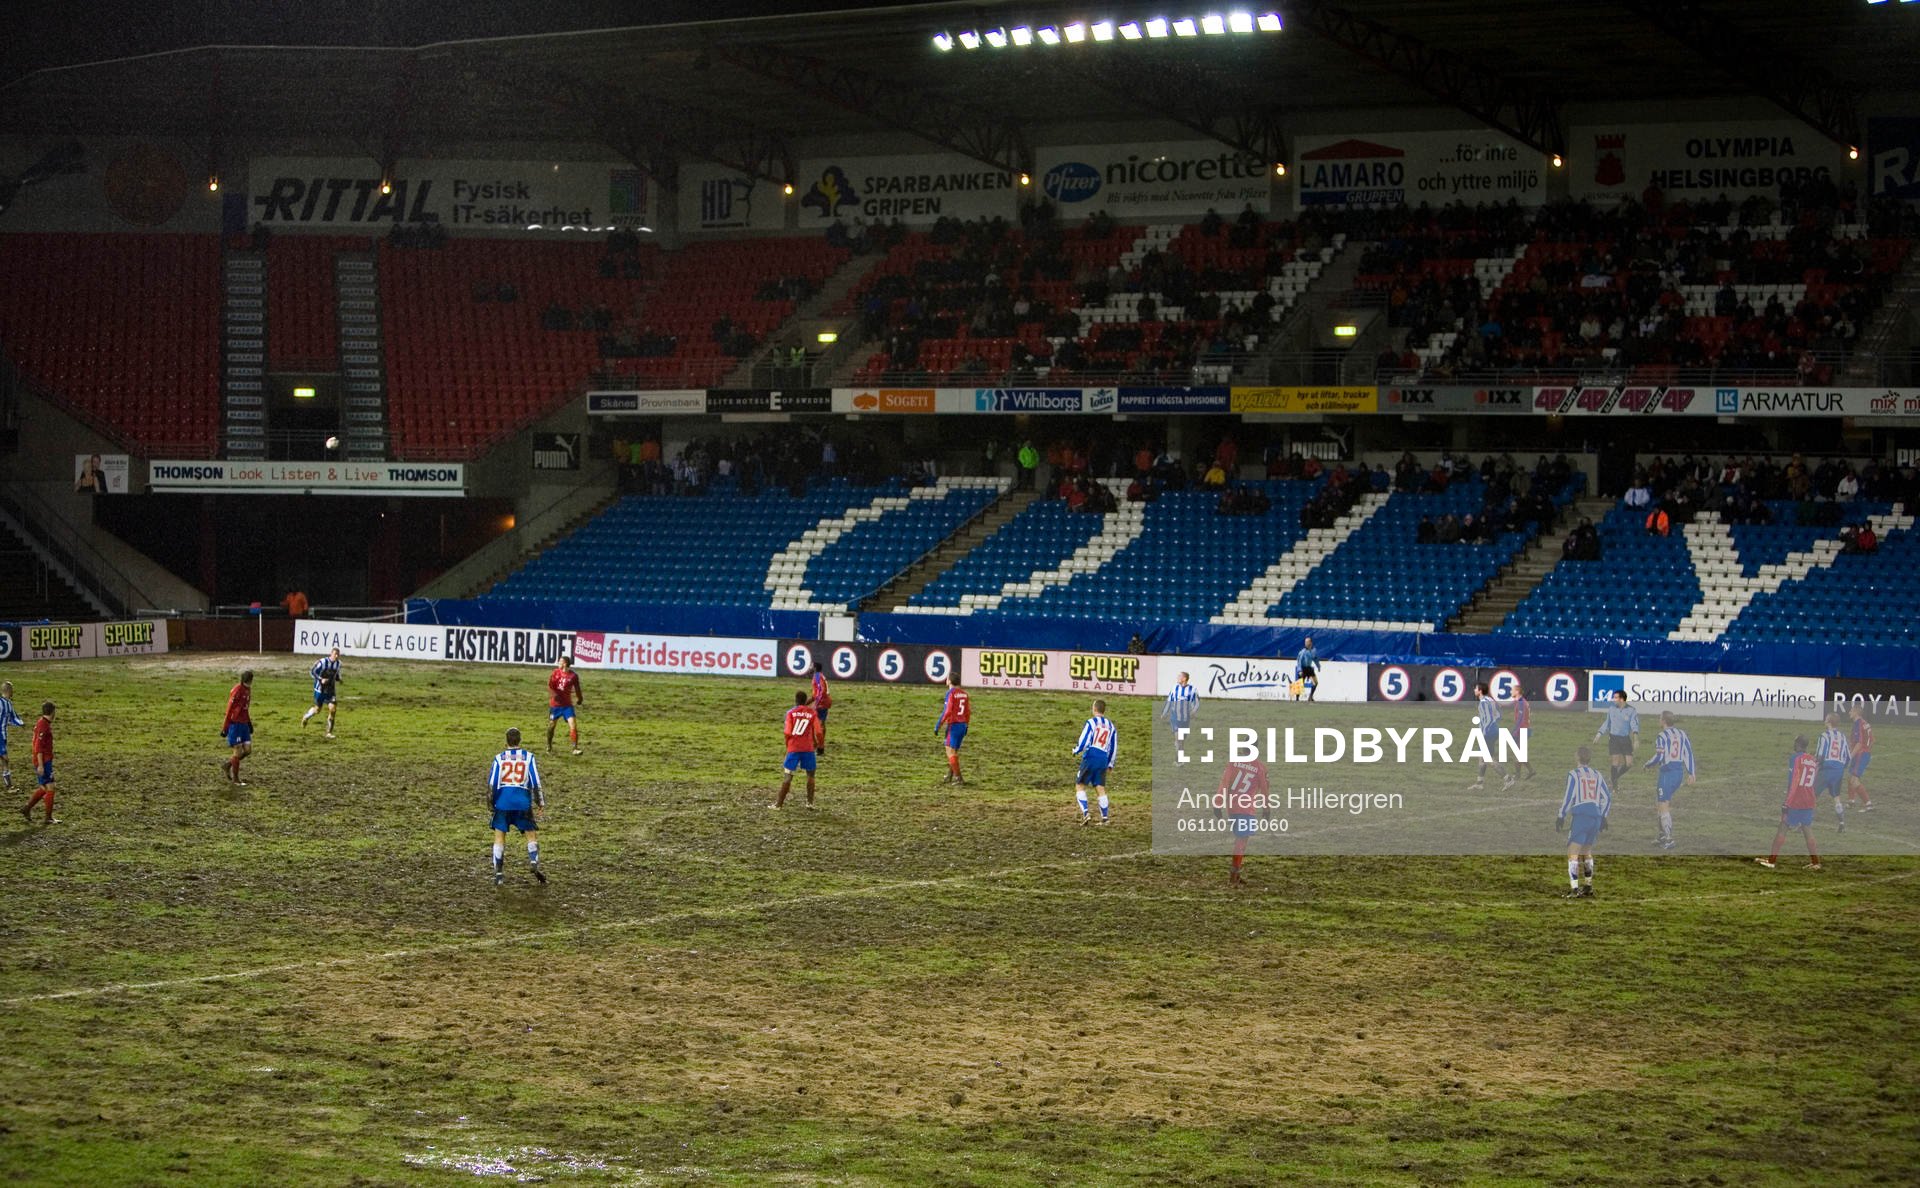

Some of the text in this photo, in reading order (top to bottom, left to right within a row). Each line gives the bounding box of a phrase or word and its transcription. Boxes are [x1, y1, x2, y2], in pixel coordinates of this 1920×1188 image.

[1486, 144, 1517, 161] inre
[1686, 137, 1795, 158] OLYMPIA
[1106, 152, 1266, 184] nicorette
[1300, 162, 1404, 189] LAMARO
[1652, 167, 1831, 190] HELSINGBORG
[454, 180, 528, 202] Fysisk
[864, 172, 1012, 194] SPARBANKEN
[1045, 165, 1099, 201] Pfizer
[1418, 170, 1538, 193] och yttre miljö
[254, 178, 437, 222] RITTAL
[702, 180, 731, 221] HD
[1151, 190, 1168, 202] med
[1172, 189, 1214, 202] Nicorette
[1239, 186, 1267, 201] Pfizer
[1345, 189, 1404, 204] GRUPPEN
[453, 205, 593, 226] IT-säkerhet
[864, 198, 942, 216] GRIPEN
[600, 397, 701, 409] Skånes Provinsbank
[707, 397, 734, 405] ELITE
[770, 391, 782, 410] E
[886, 395, 928, 408] SOGETI
[1012, 391, 1081, 412] Wihlborgs
[1120, 396, 1151, 405] PAPPRET
[1157, 395, 1183, 405] HÖGSTA
[1184, 396, 1226, 405] DIVISIONEN!
[1401, 389, 1434, 403] IXX
[1488, 390, 1521, 404] IXX
[1718, 391, 1736, 411] LK
[1742, 392, 1844, 411] ARMATUR
[1870, 398, 1897, 409] mix
[534, 450, 568, 468] PUMA
[153, 466, 457, 481] THOMSON Look Listen & Live THOMSON
[30, 626, 83, 650] SPORT
[104, 622, 155, 647] SPORT
[300, 630, 439, 652] ROYAL LEAGUE
[575, 636, 603, 651] Ekstra
[32, 650, 82, 658] BLADET
[107, 645, 154, 654] BLADET
[445, 628, 577, 665] EKSTRA BLADET
[574, 646, 603, 661] Bladet
[608, 639, 773, 671] fritidsresor.se
[793, 650, 805, 670] 5
[839, 652, 851, 673] 5
[884, 655, 898, 675] 5
[932, 656, 945, 677] 5
[980, 651, 1047, 677] SPORT
[1070, 654, 1139, 682] SPORT
[982, 677, 1045, 688] BLADET
[1072, 681, 1136, 692] BLADET
[1208, 661, 1293, 695] Radisson
[1387, 673, 1402, 695] 5
[1442, 675, 1457, 697] 5
[1497, 677, 1512, 699] 5
[1553, 678, 1569, 701] 5
[1631, 684, 1816, 710] Scandinavian Airlines
[957, 699, 965, 715] 5
[1834, 692, 1919, 717] ROYAL
[792, 718, 810, 735] 10
[1093, 727, 1109, 747] 14
[1671, 741, 1679, 759] 3
[1830, 740, 1840, 758] 5
[501, 761, 526, 783] 29
[1231, 770, 1255, 793] 15
[1799, 766, 1816, 787] 13
[1581, 778, 1596, 800] 15
